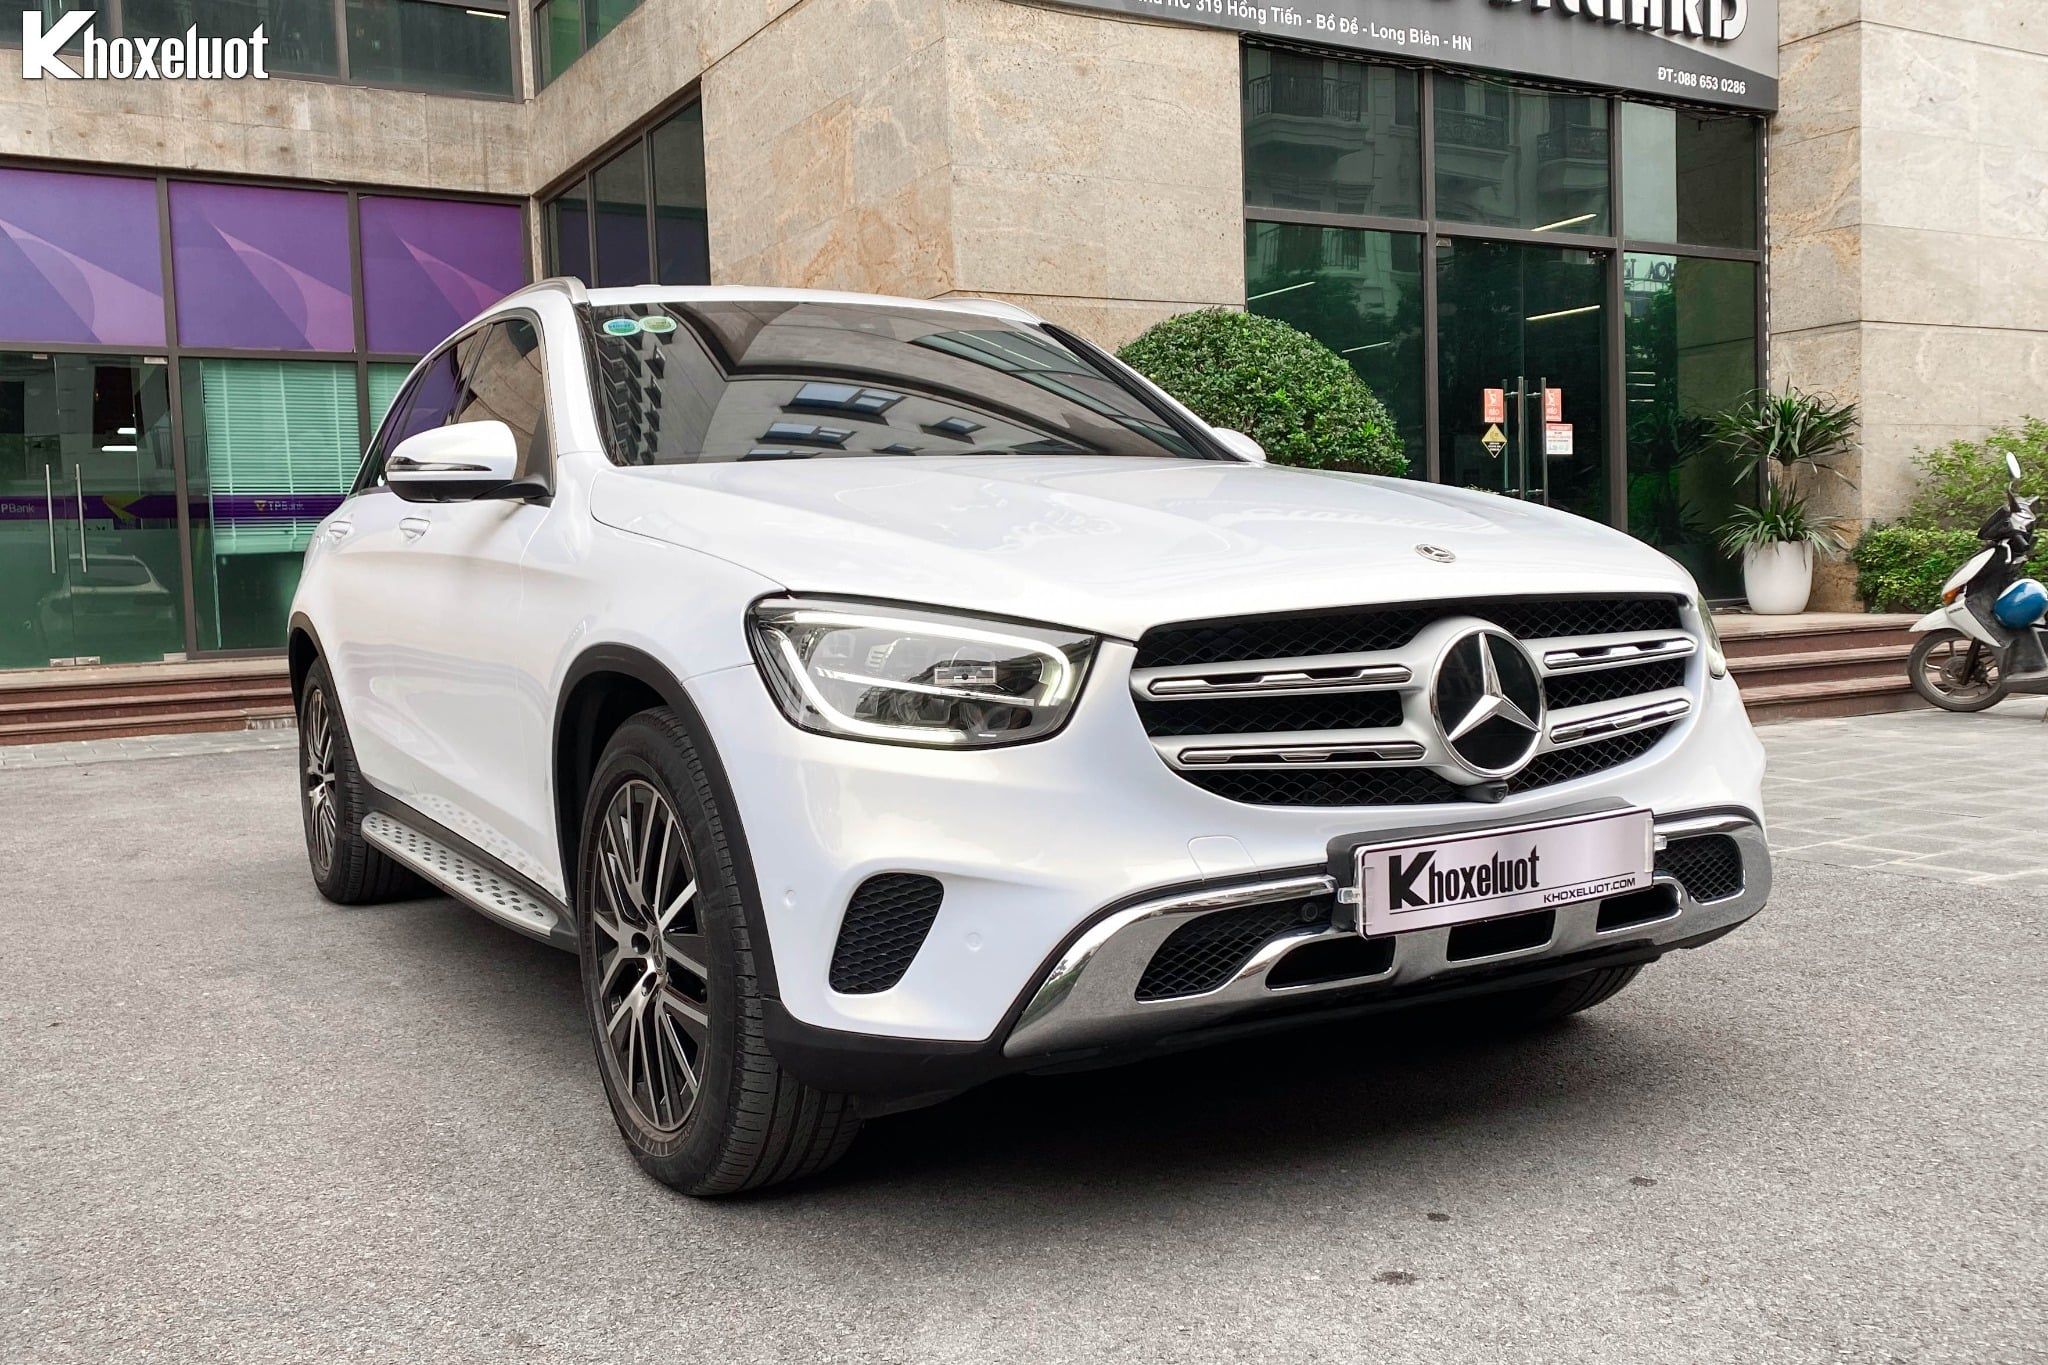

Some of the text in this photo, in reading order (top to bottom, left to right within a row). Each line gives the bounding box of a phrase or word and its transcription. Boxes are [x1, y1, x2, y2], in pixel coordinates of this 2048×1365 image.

[1196, 0, 1223, 13] 319
[1270, 6, 1302, 26] Tiến
[1371, 22, 1405, 45] Long
[1410, 28, 1440, 47] Biên
[1452, 34, 1472, 51] HN
[1699, 74, 1718, 90] 653
[1721, 78, 1746, 95] 0286
[0, 503, 34, 513] PBank
[1388, 845, 1540, 910] Khoxeluot
[1543, 878, 1636, 903] KHOXELUOT.COM
